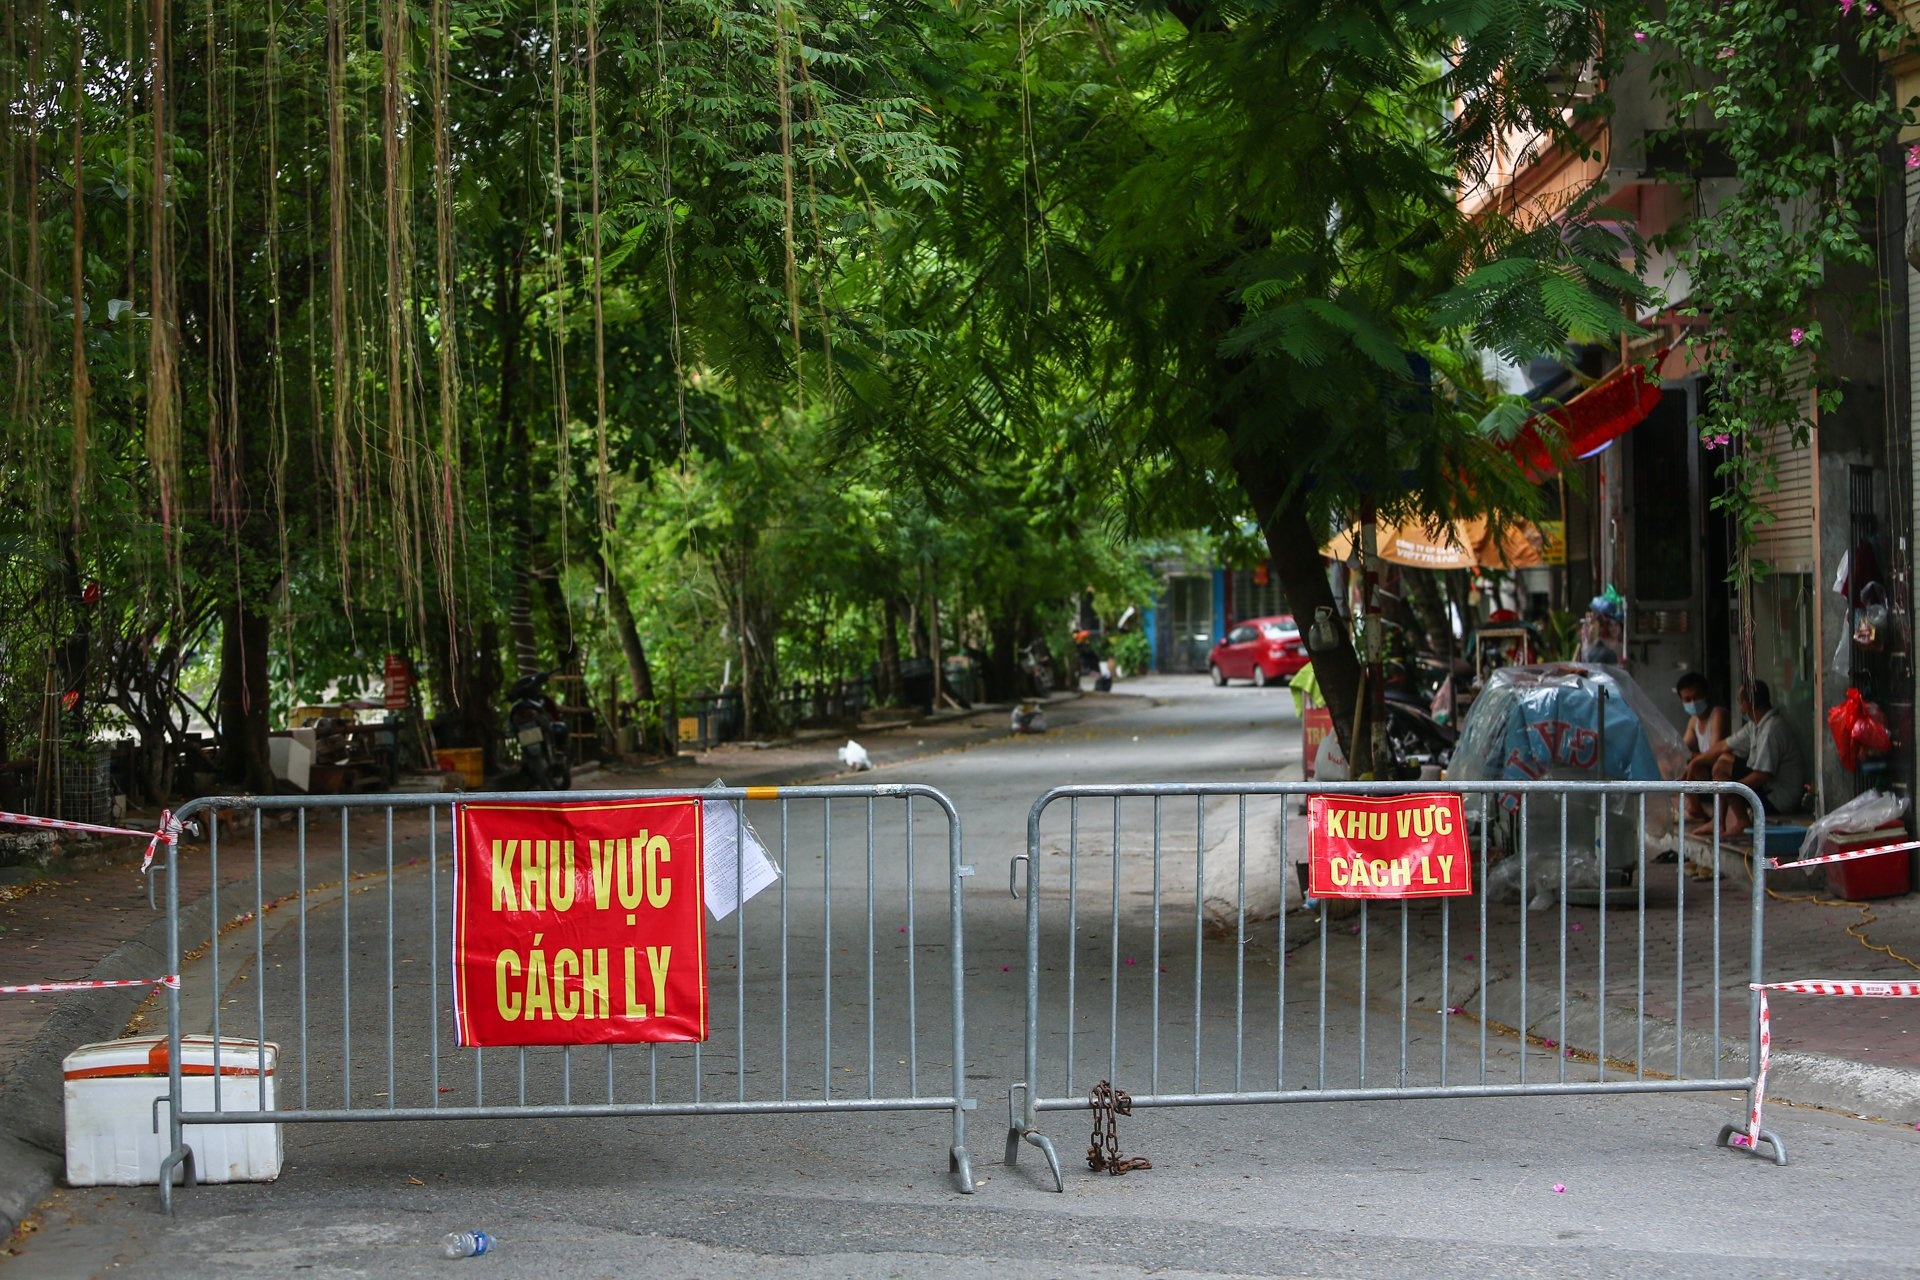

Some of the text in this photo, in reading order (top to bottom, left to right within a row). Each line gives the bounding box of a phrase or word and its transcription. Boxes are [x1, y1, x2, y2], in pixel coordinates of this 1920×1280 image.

[1327, 804, 1453, 843] KHU VỰC
[491, 839, 576, 912] KHU
[589, 828, 672, 926] VỰC
[1330, 852, 1453, 887] CÁCH LY
[495, 933, 672, 1022] CÁCH LY
